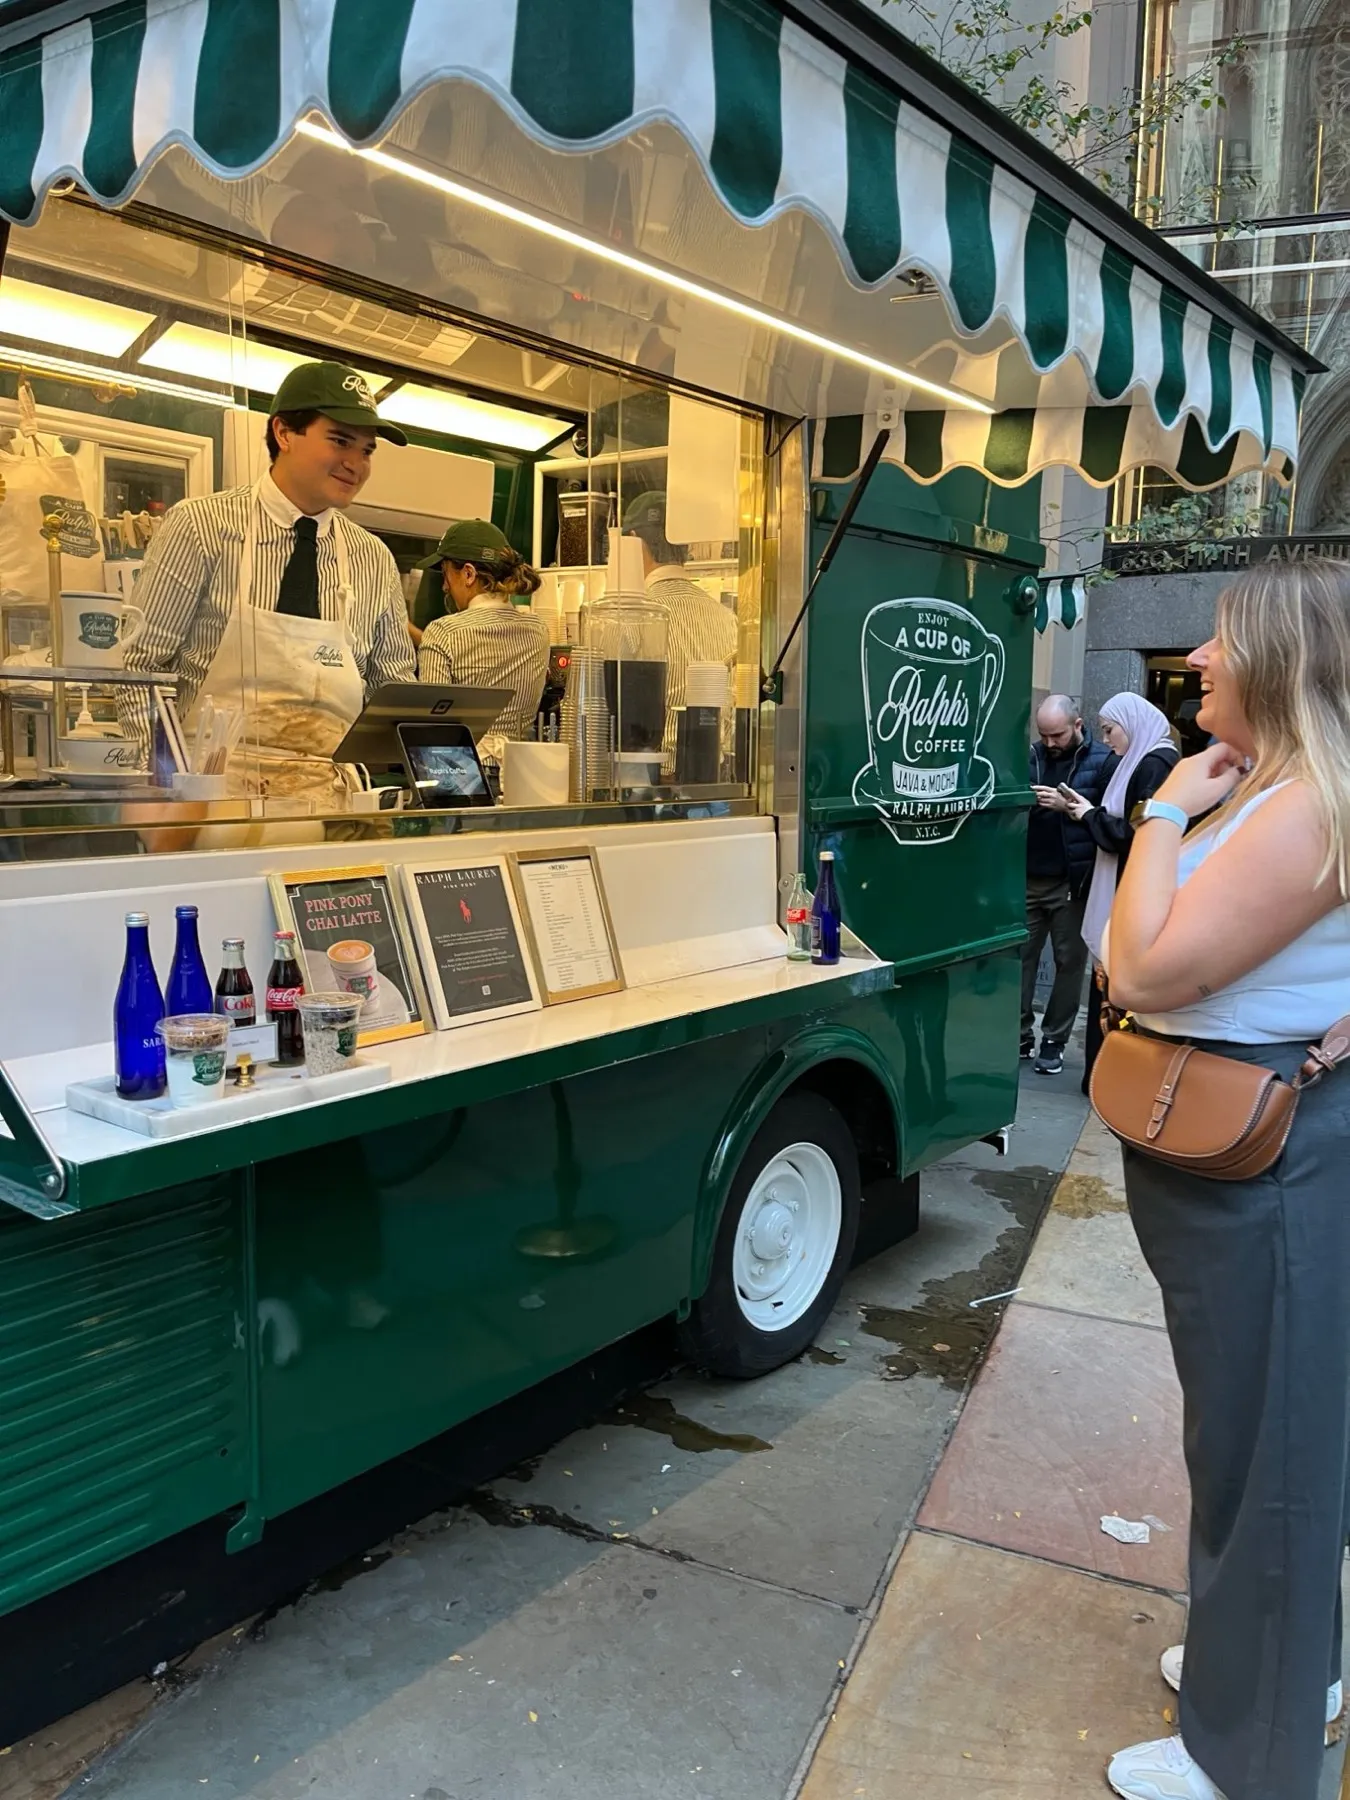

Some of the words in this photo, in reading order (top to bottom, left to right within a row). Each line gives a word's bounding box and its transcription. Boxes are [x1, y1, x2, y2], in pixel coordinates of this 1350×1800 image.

[918, 613, 949, 627] ENJOY
[895, 627, 909, 648] A
[914, 627, 948, 650] CUP
[951, 636, 971, 658] OF
[877, 665, 969, 762] Ralph's
[914, 739, 966, 753] COFFEE
[896, 770, 919, 792] JAVA
[921, 778, 927, 791] &
[928, 770, 955, 793] MOCHA
[893, 801, 931, 816] RALPH
[935, 796, 977, 816] LAUREN
[415, 872, 452, 885] RALPH
[457, 868, 498, 881] LAUREN
[305, 897, 338, 913] PINK
[338, 893, 373, 909] PONY
[306, 915, 340, 932] CHAI
[341, 910, 382, 927] LATTE
